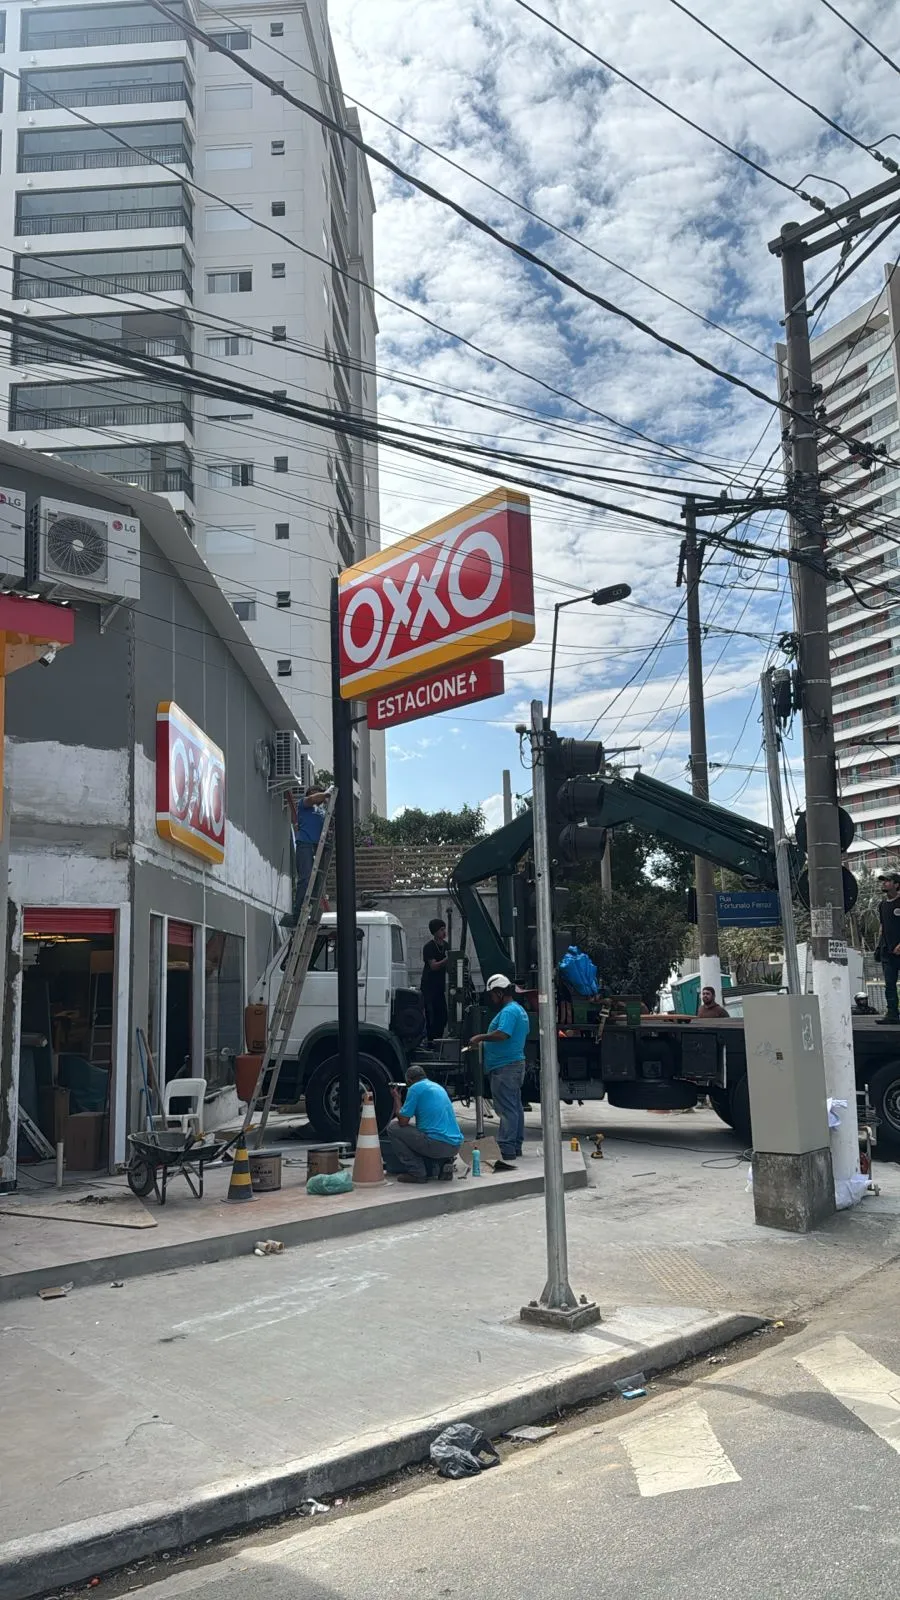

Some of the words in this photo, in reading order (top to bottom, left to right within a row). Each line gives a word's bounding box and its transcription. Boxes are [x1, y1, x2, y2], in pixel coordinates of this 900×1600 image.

[8, 497, 21, 507] LG
[124, 523, 136, 533] LG
[343, 530, 504, 664] OXXO
[377, 672, 467, 720] ESTACIONE
[171, 737, 224, 837] OXXO
[719, 895, 732, 903] Rua
